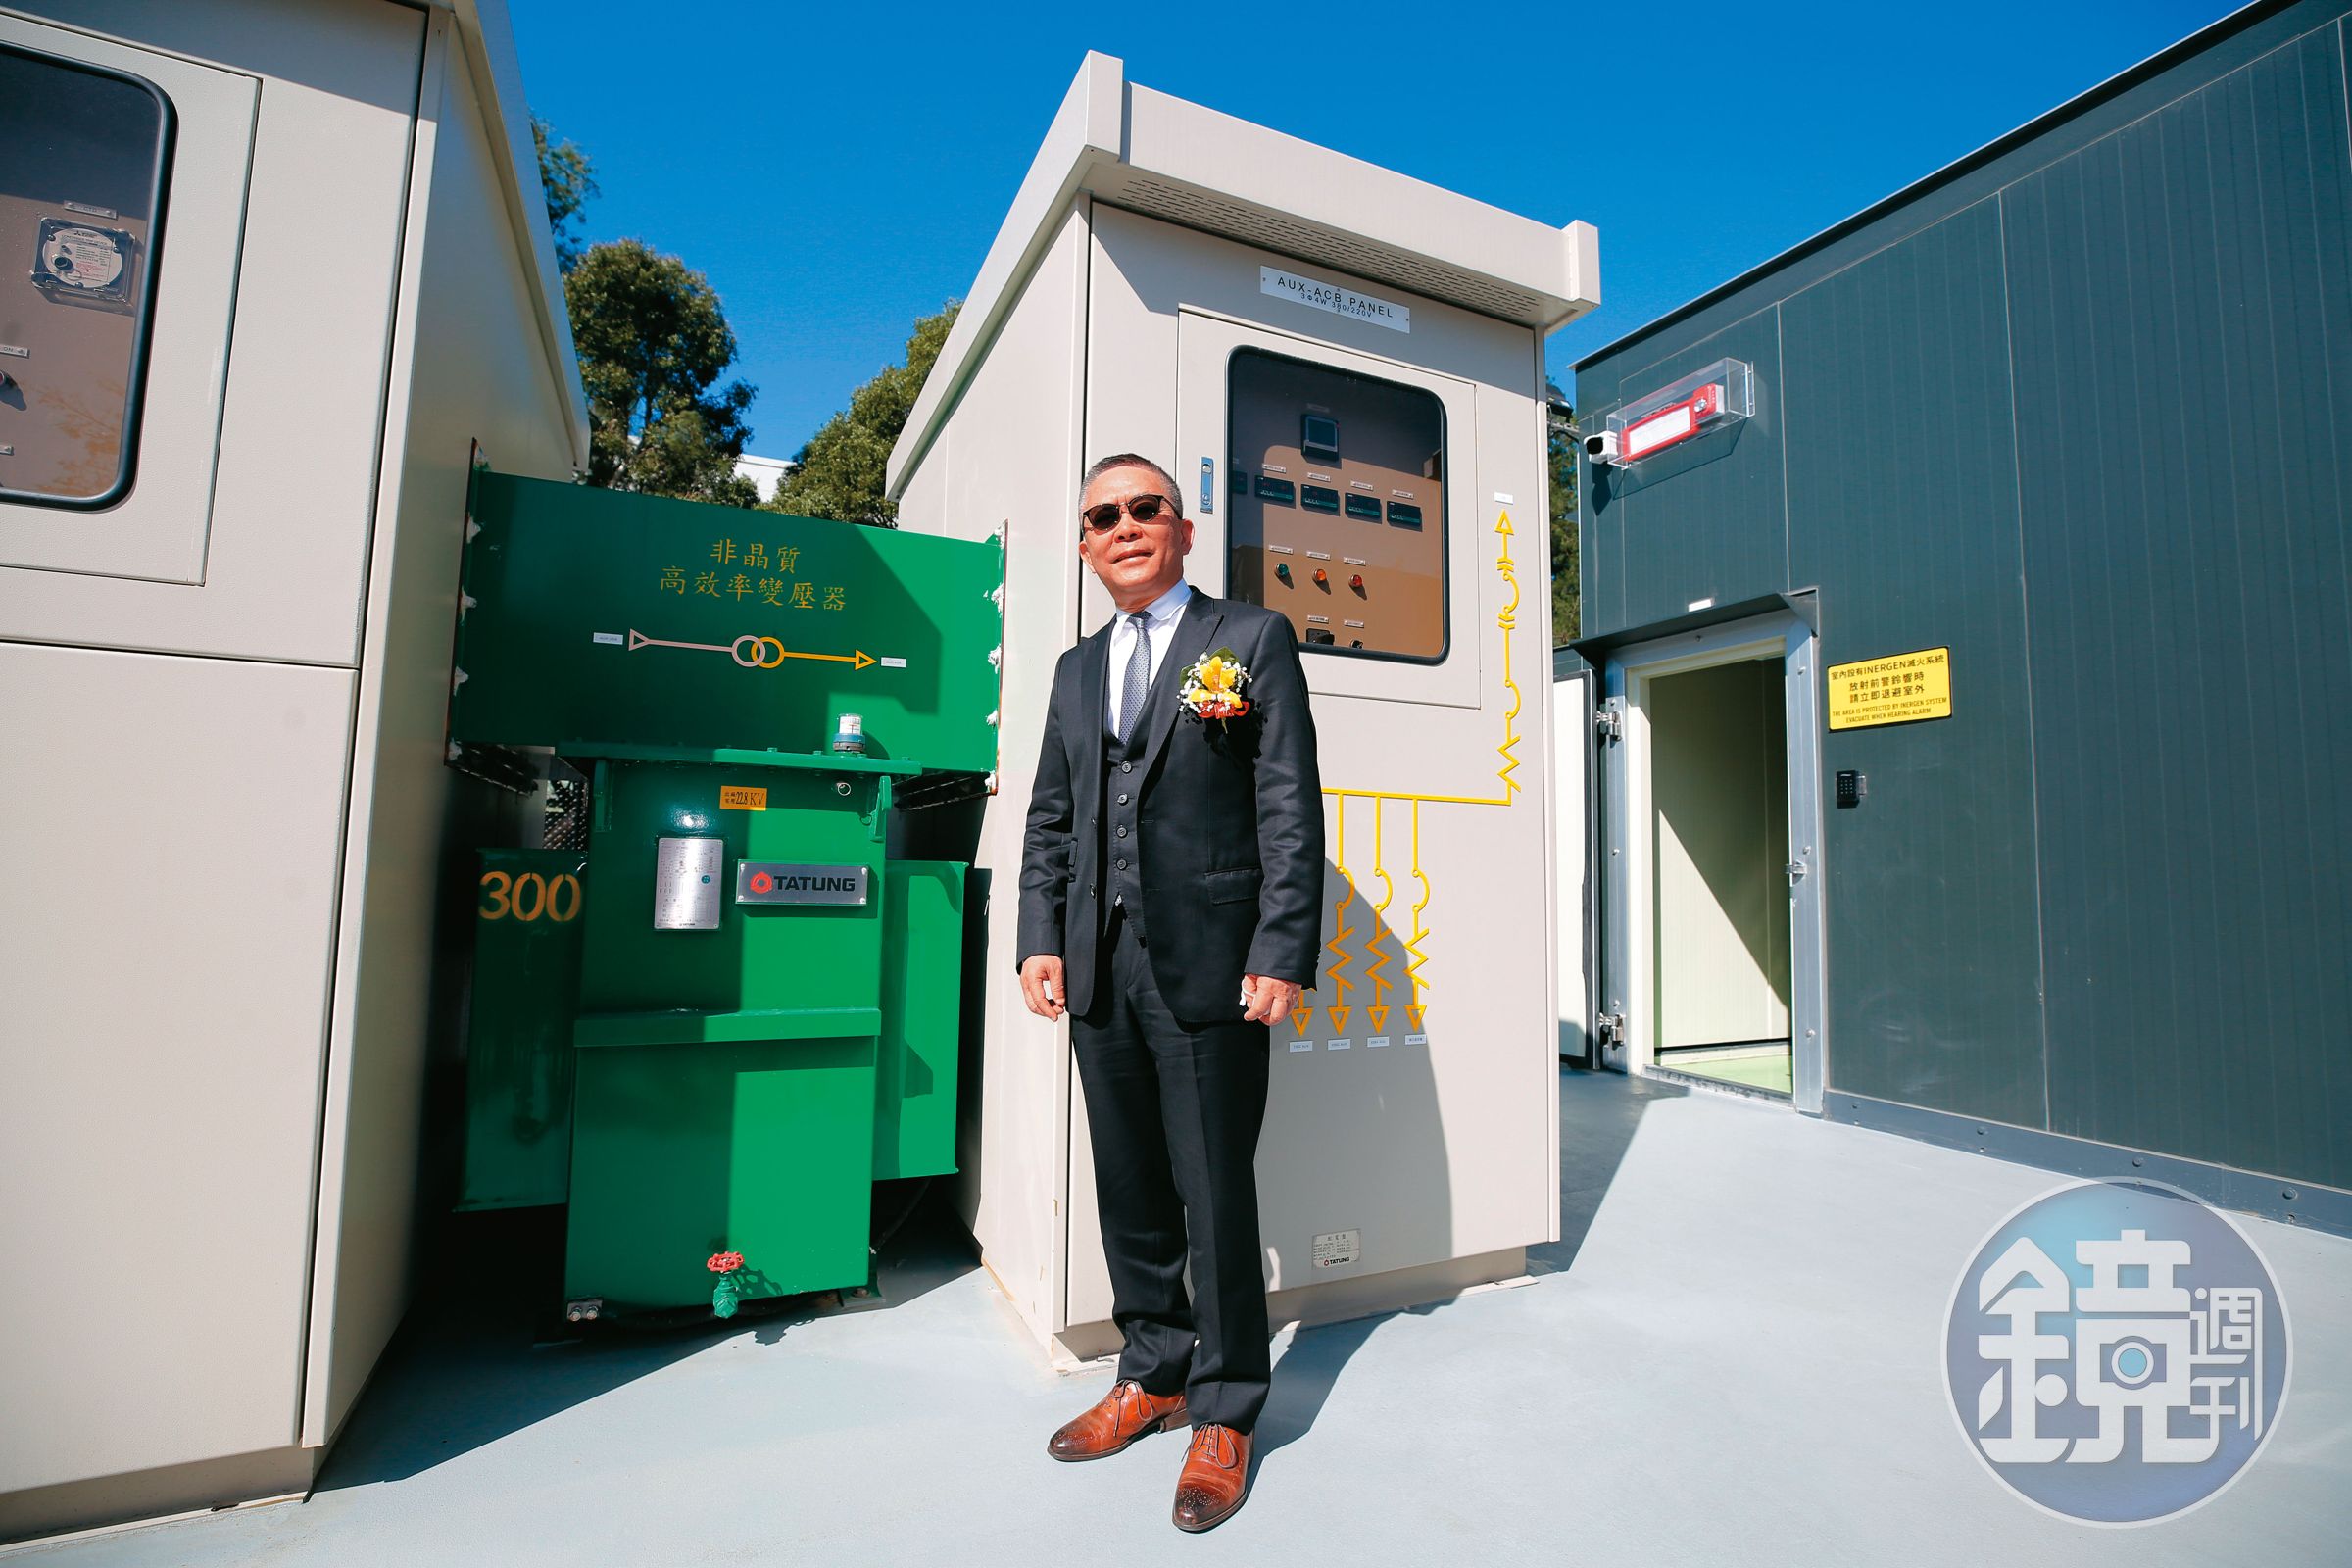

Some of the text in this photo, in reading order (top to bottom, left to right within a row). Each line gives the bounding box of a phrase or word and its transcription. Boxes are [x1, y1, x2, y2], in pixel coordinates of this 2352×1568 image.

[1277, 276, 1394, 318] AUX-ACB PANEL
[1331, 301, 1372, 318] 380/220V
[710, 538, 801, 574] 非晶質
[660, 565, 846, 611] 高效率變壓器
[1849, 671, 1925, 692] 放射前警鈴響時
[1849, 684, 1925, 704] 請立即退避室外
[1862, 704, 1891, 713] PROTECTED
[1925, 697, 1947, 706] SYSTEM
[1846, 714, 1870, 723] EVACUATE
[750, 792, 765, 806] KV
[773, 875, 856, 892] TATUNG
[478, 870, 581, 922] 300
[1329, 1256, 1350, 1265] TATUNG
